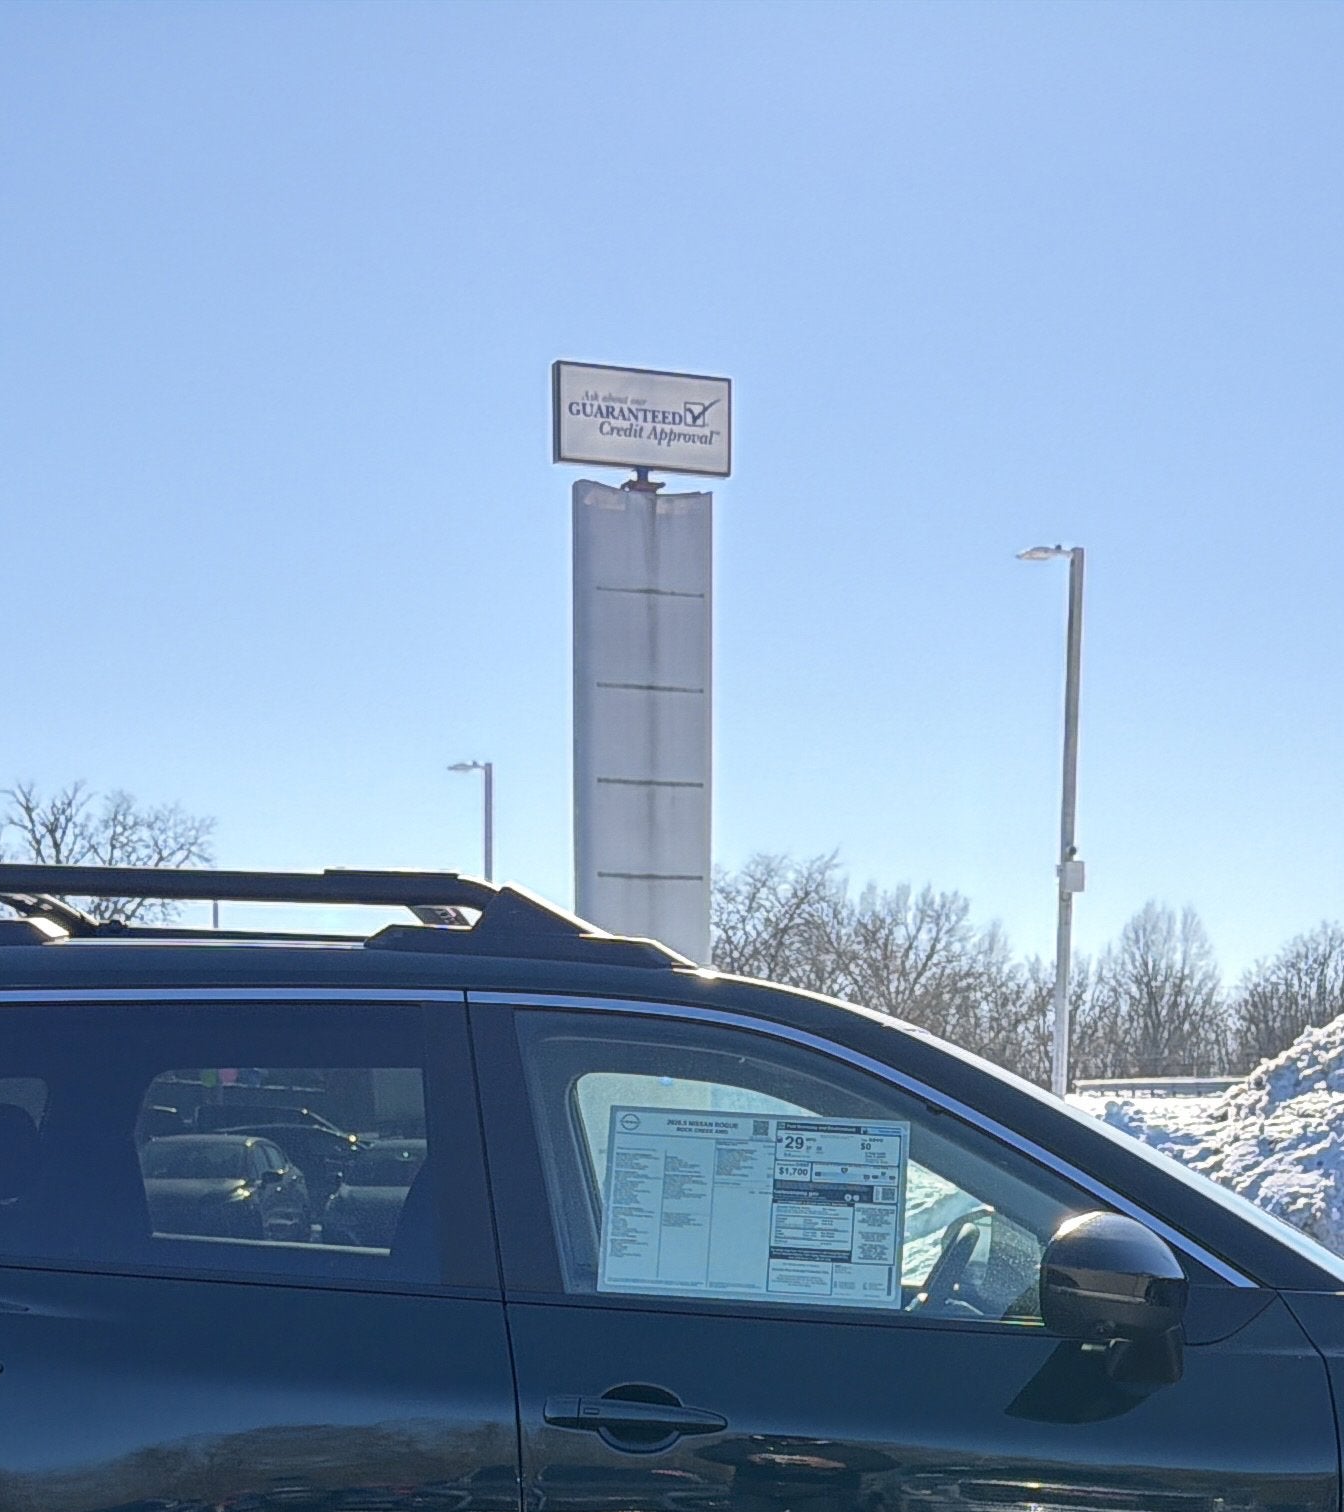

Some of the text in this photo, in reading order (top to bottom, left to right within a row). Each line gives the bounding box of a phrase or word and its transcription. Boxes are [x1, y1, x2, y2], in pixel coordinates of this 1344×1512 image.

[568, 401, 683, 426] GUARANTEED
[599, 420, 644, 440] Credit
[784, 1135, 805, 1150] 29
[860, 1142, 872, 1151] $0
[778, 1166, 809, 1177] $1,700
